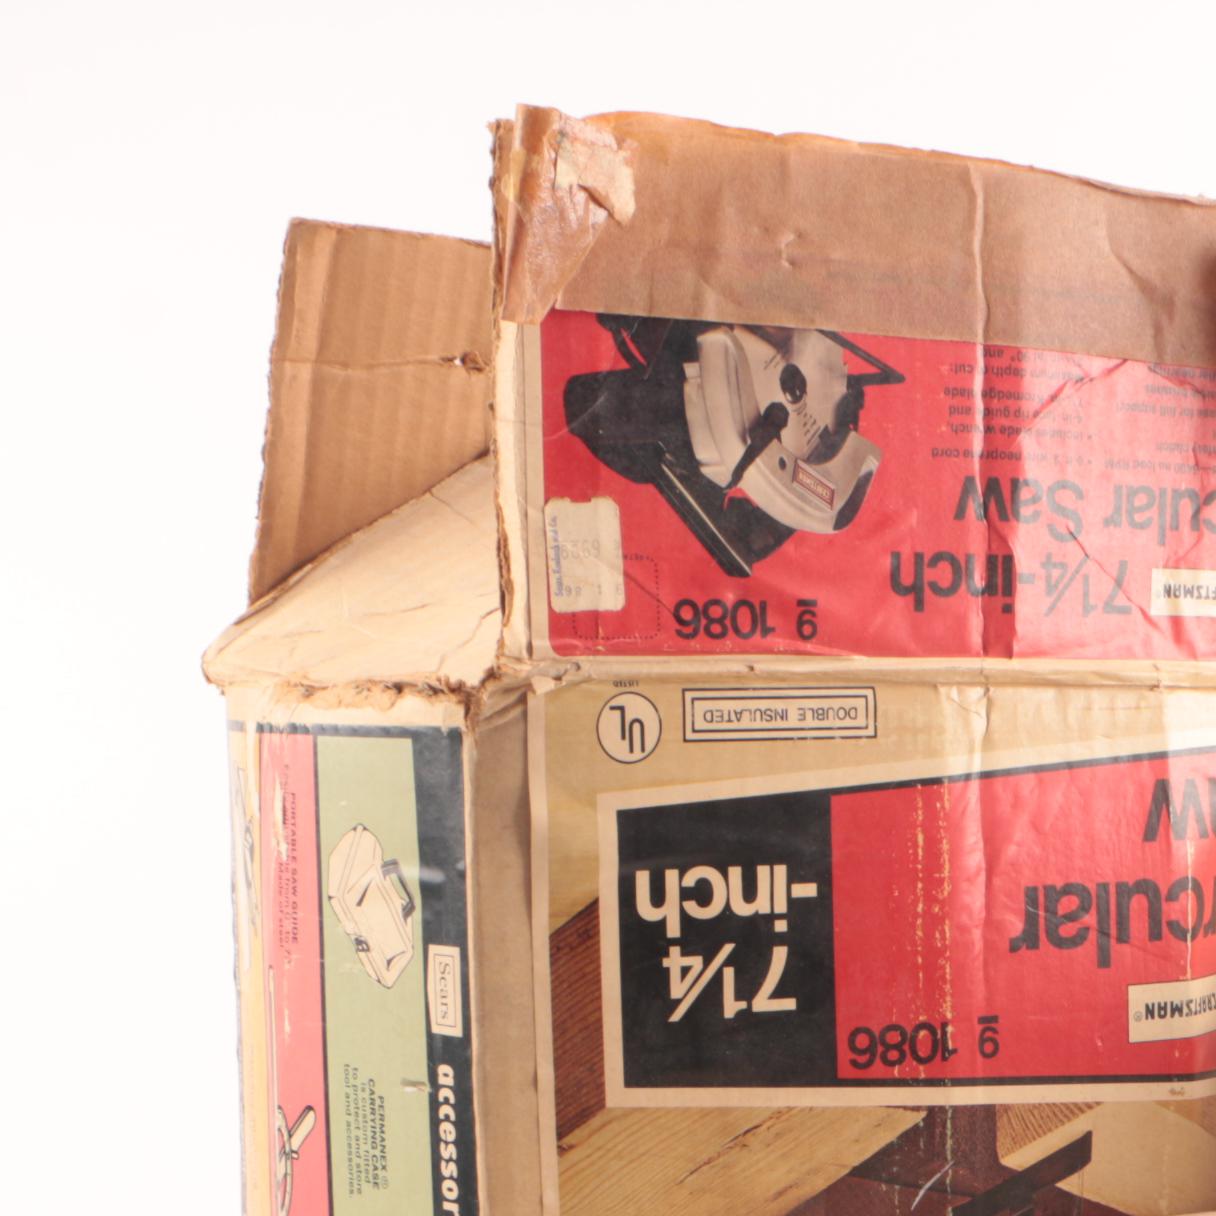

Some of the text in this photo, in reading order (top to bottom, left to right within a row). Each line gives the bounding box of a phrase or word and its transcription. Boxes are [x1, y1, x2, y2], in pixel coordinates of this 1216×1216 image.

[947, 405, 970, 417] and
[930, 445, 959, 458] cord
[952, 473, 1083, 542] Saw
[671, 596, 817, 640] 9 1086
[608, 704, 645, 754] UL
[702, 705, 858, 723] DOUBLE INSULATED
[289, 792, 297, 864] PORTABLE
[290, 901, 298, 945] GUIDE
[437, 961, 453, 1021] Sears
[846, 1020, 999, 1070] 9 1086
[342, 1063, 350, 1088] tool
[343, 1091, 351, 1117] and
[350, 1084, 360, 1131] protect
[360, 1096, 368, 1146] custom
[353, 1134, 361, 1159] and
[367, 1078, 379, 1190] CARRYING CASE
[354, 1162, 362, 1196] store
[362, 1150, 371, 1184] fitted
